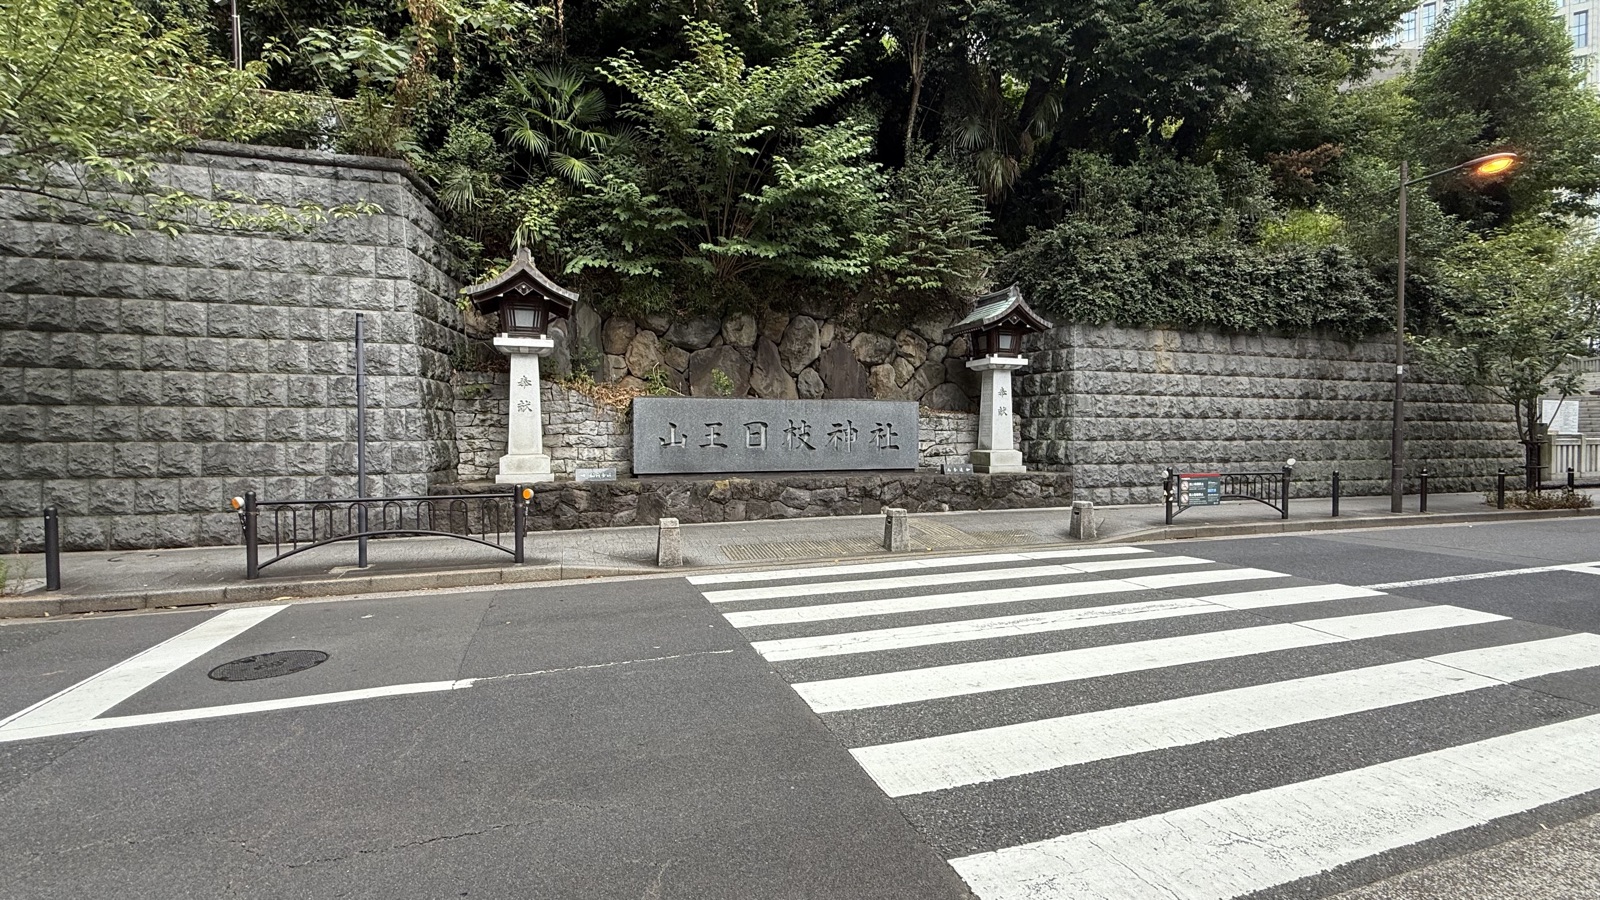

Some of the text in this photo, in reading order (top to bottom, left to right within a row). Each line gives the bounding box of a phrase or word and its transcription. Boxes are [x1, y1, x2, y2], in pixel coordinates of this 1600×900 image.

[517, 374, 532, 412] 奉献
[997, 386, 1008, 416] 奉献
[659, 419, 900, 452] 山王日枝神社
